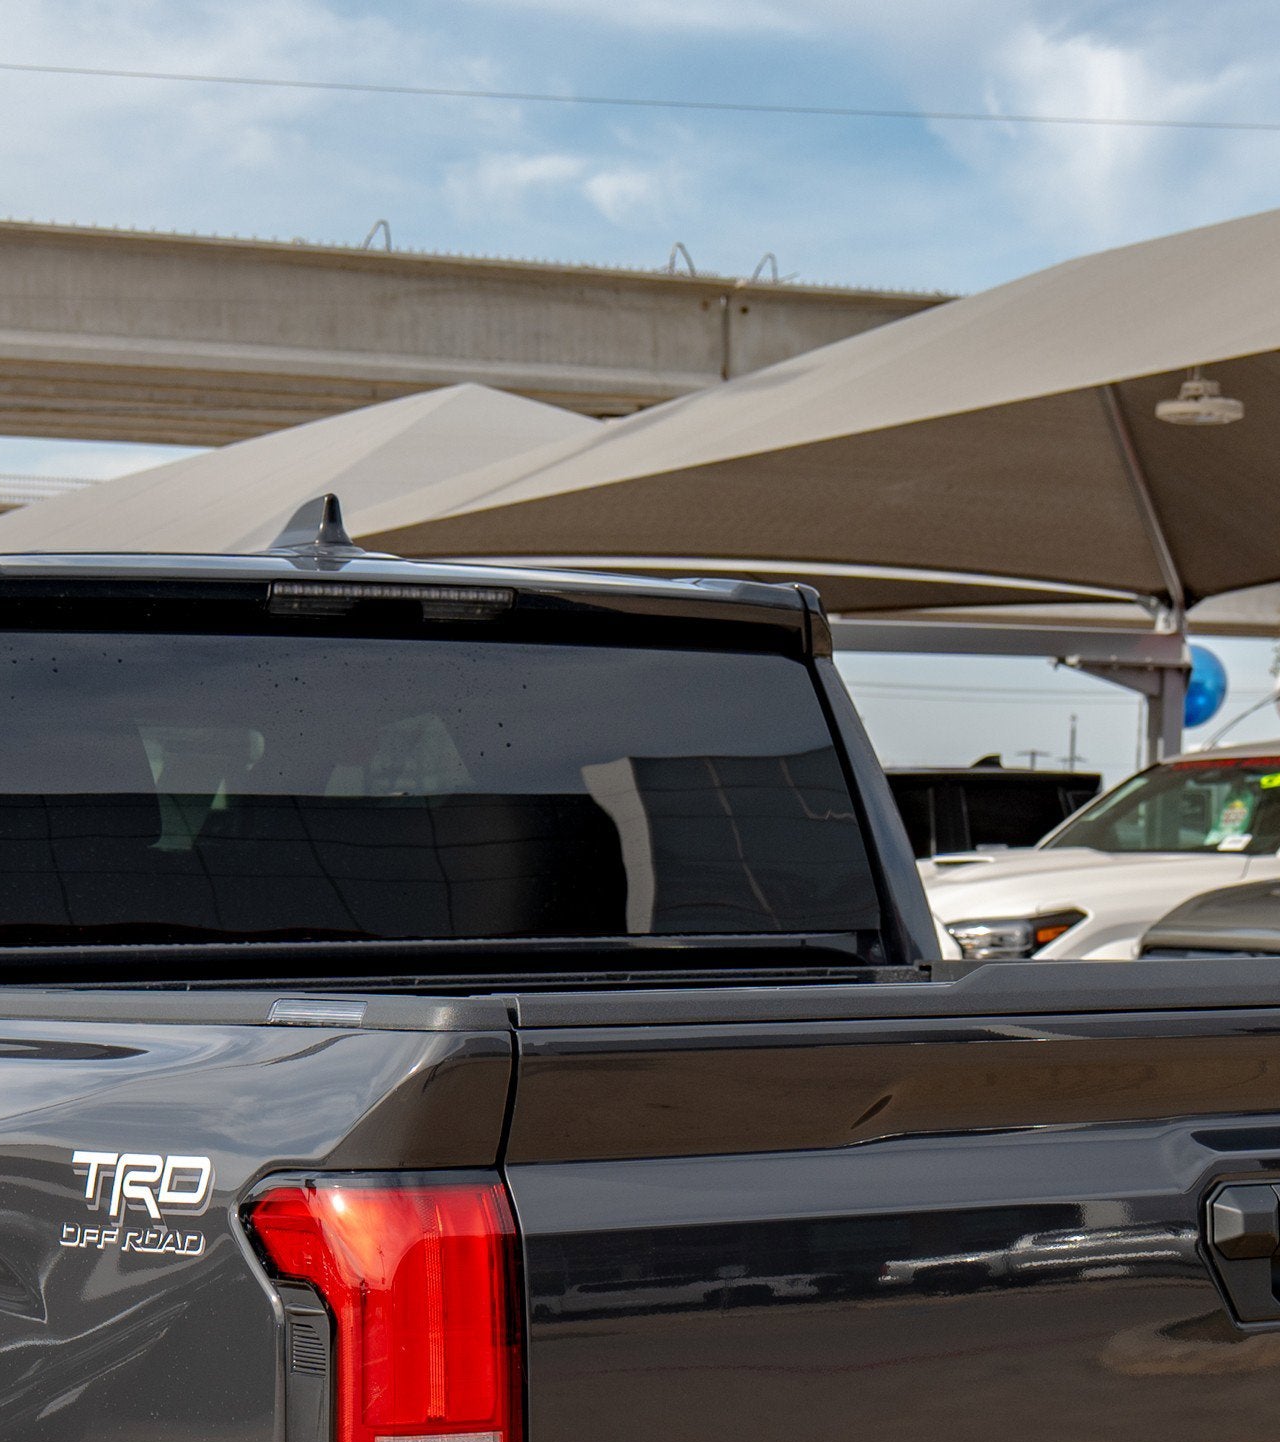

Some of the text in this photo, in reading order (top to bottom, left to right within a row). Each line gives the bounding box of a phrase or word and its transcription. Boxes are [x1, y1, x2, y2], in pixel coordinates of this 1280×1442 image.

[71, 1150, 213, 1221] TRD
[59, 1222, 207, 1257] OFF ROAD
